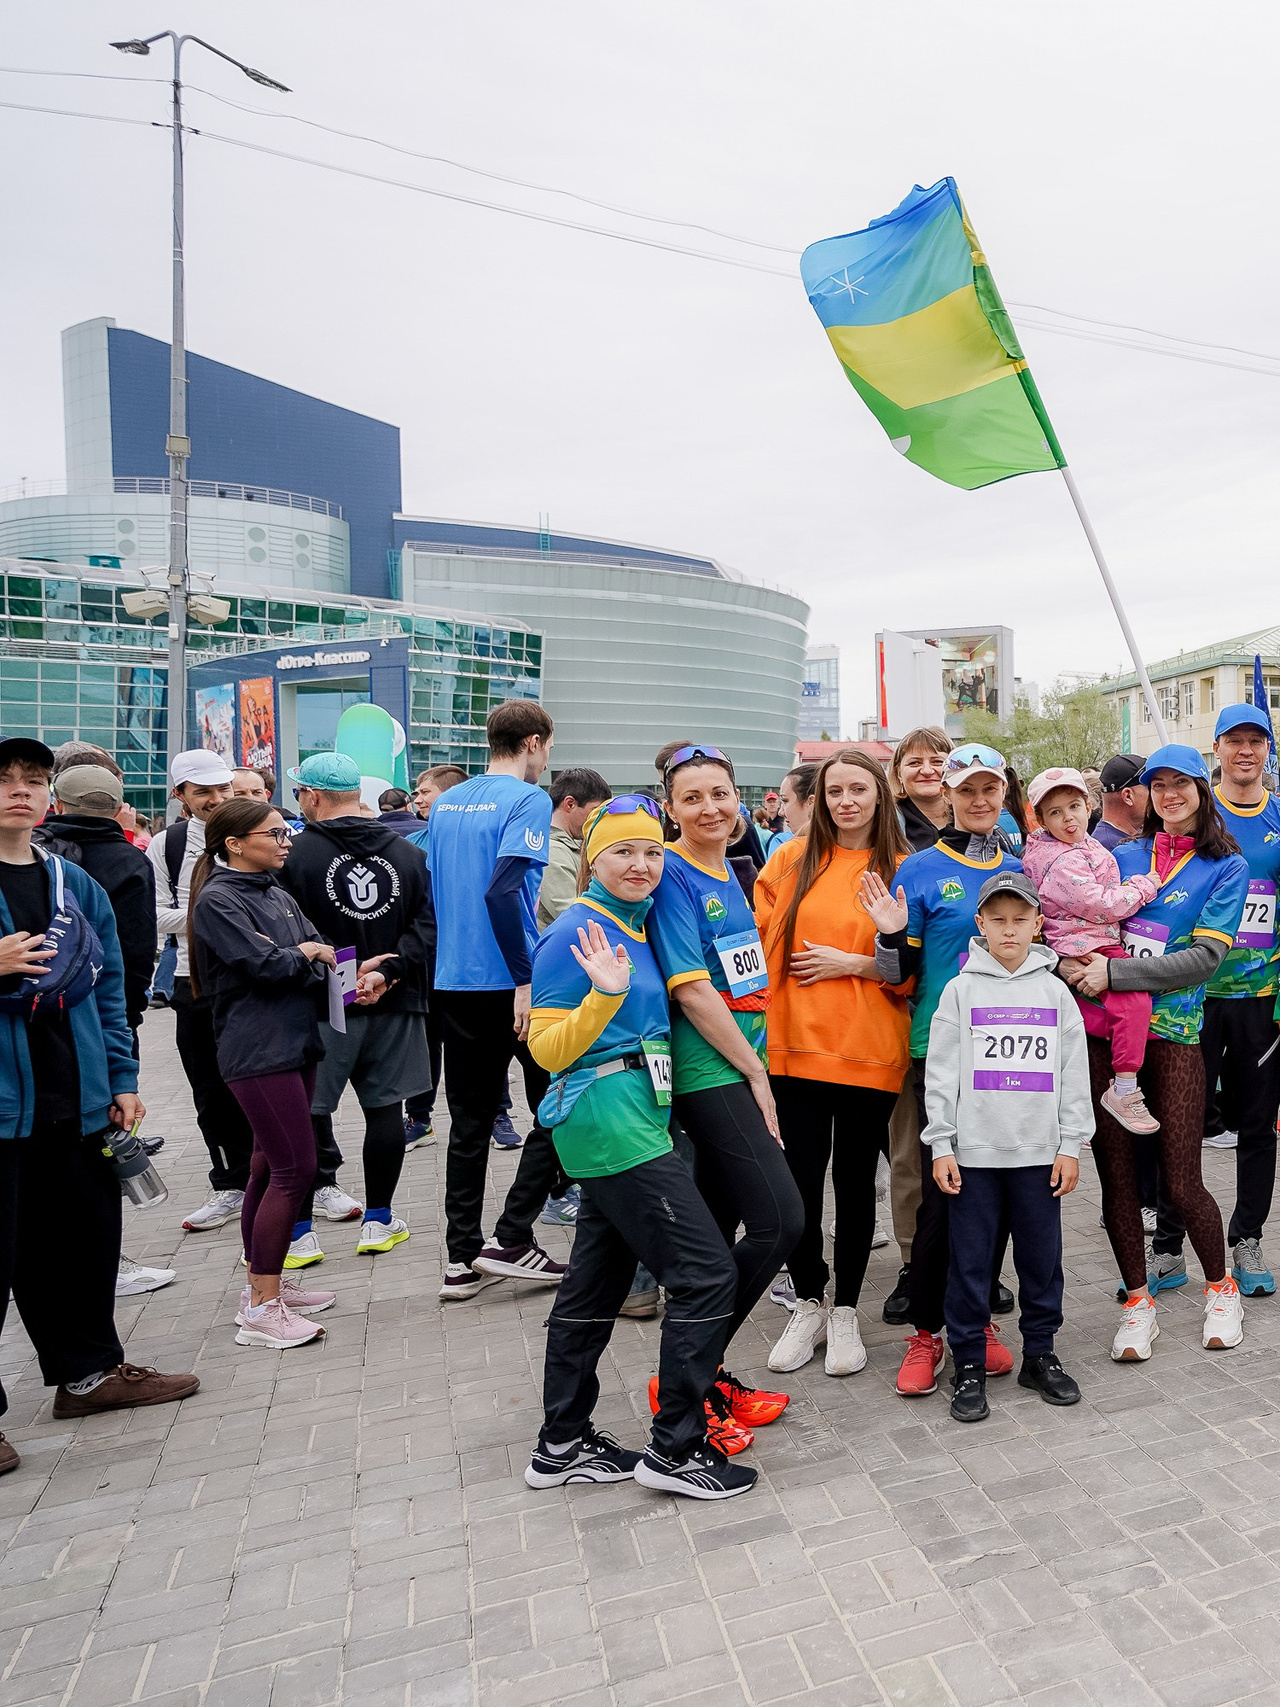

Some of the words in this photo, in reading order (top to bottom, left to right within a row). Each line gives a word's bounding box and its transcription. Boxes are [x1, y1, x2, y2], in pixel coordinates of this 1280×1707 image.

[326, 856, 343, 901] ЮГОРСКИЙ
[1245, 902, 1269, 923] 72
[23, 913, 72, 985] JDAN
[733, 948, 760, 976] 800
[985, 1035, 1048, 1061] 2078
